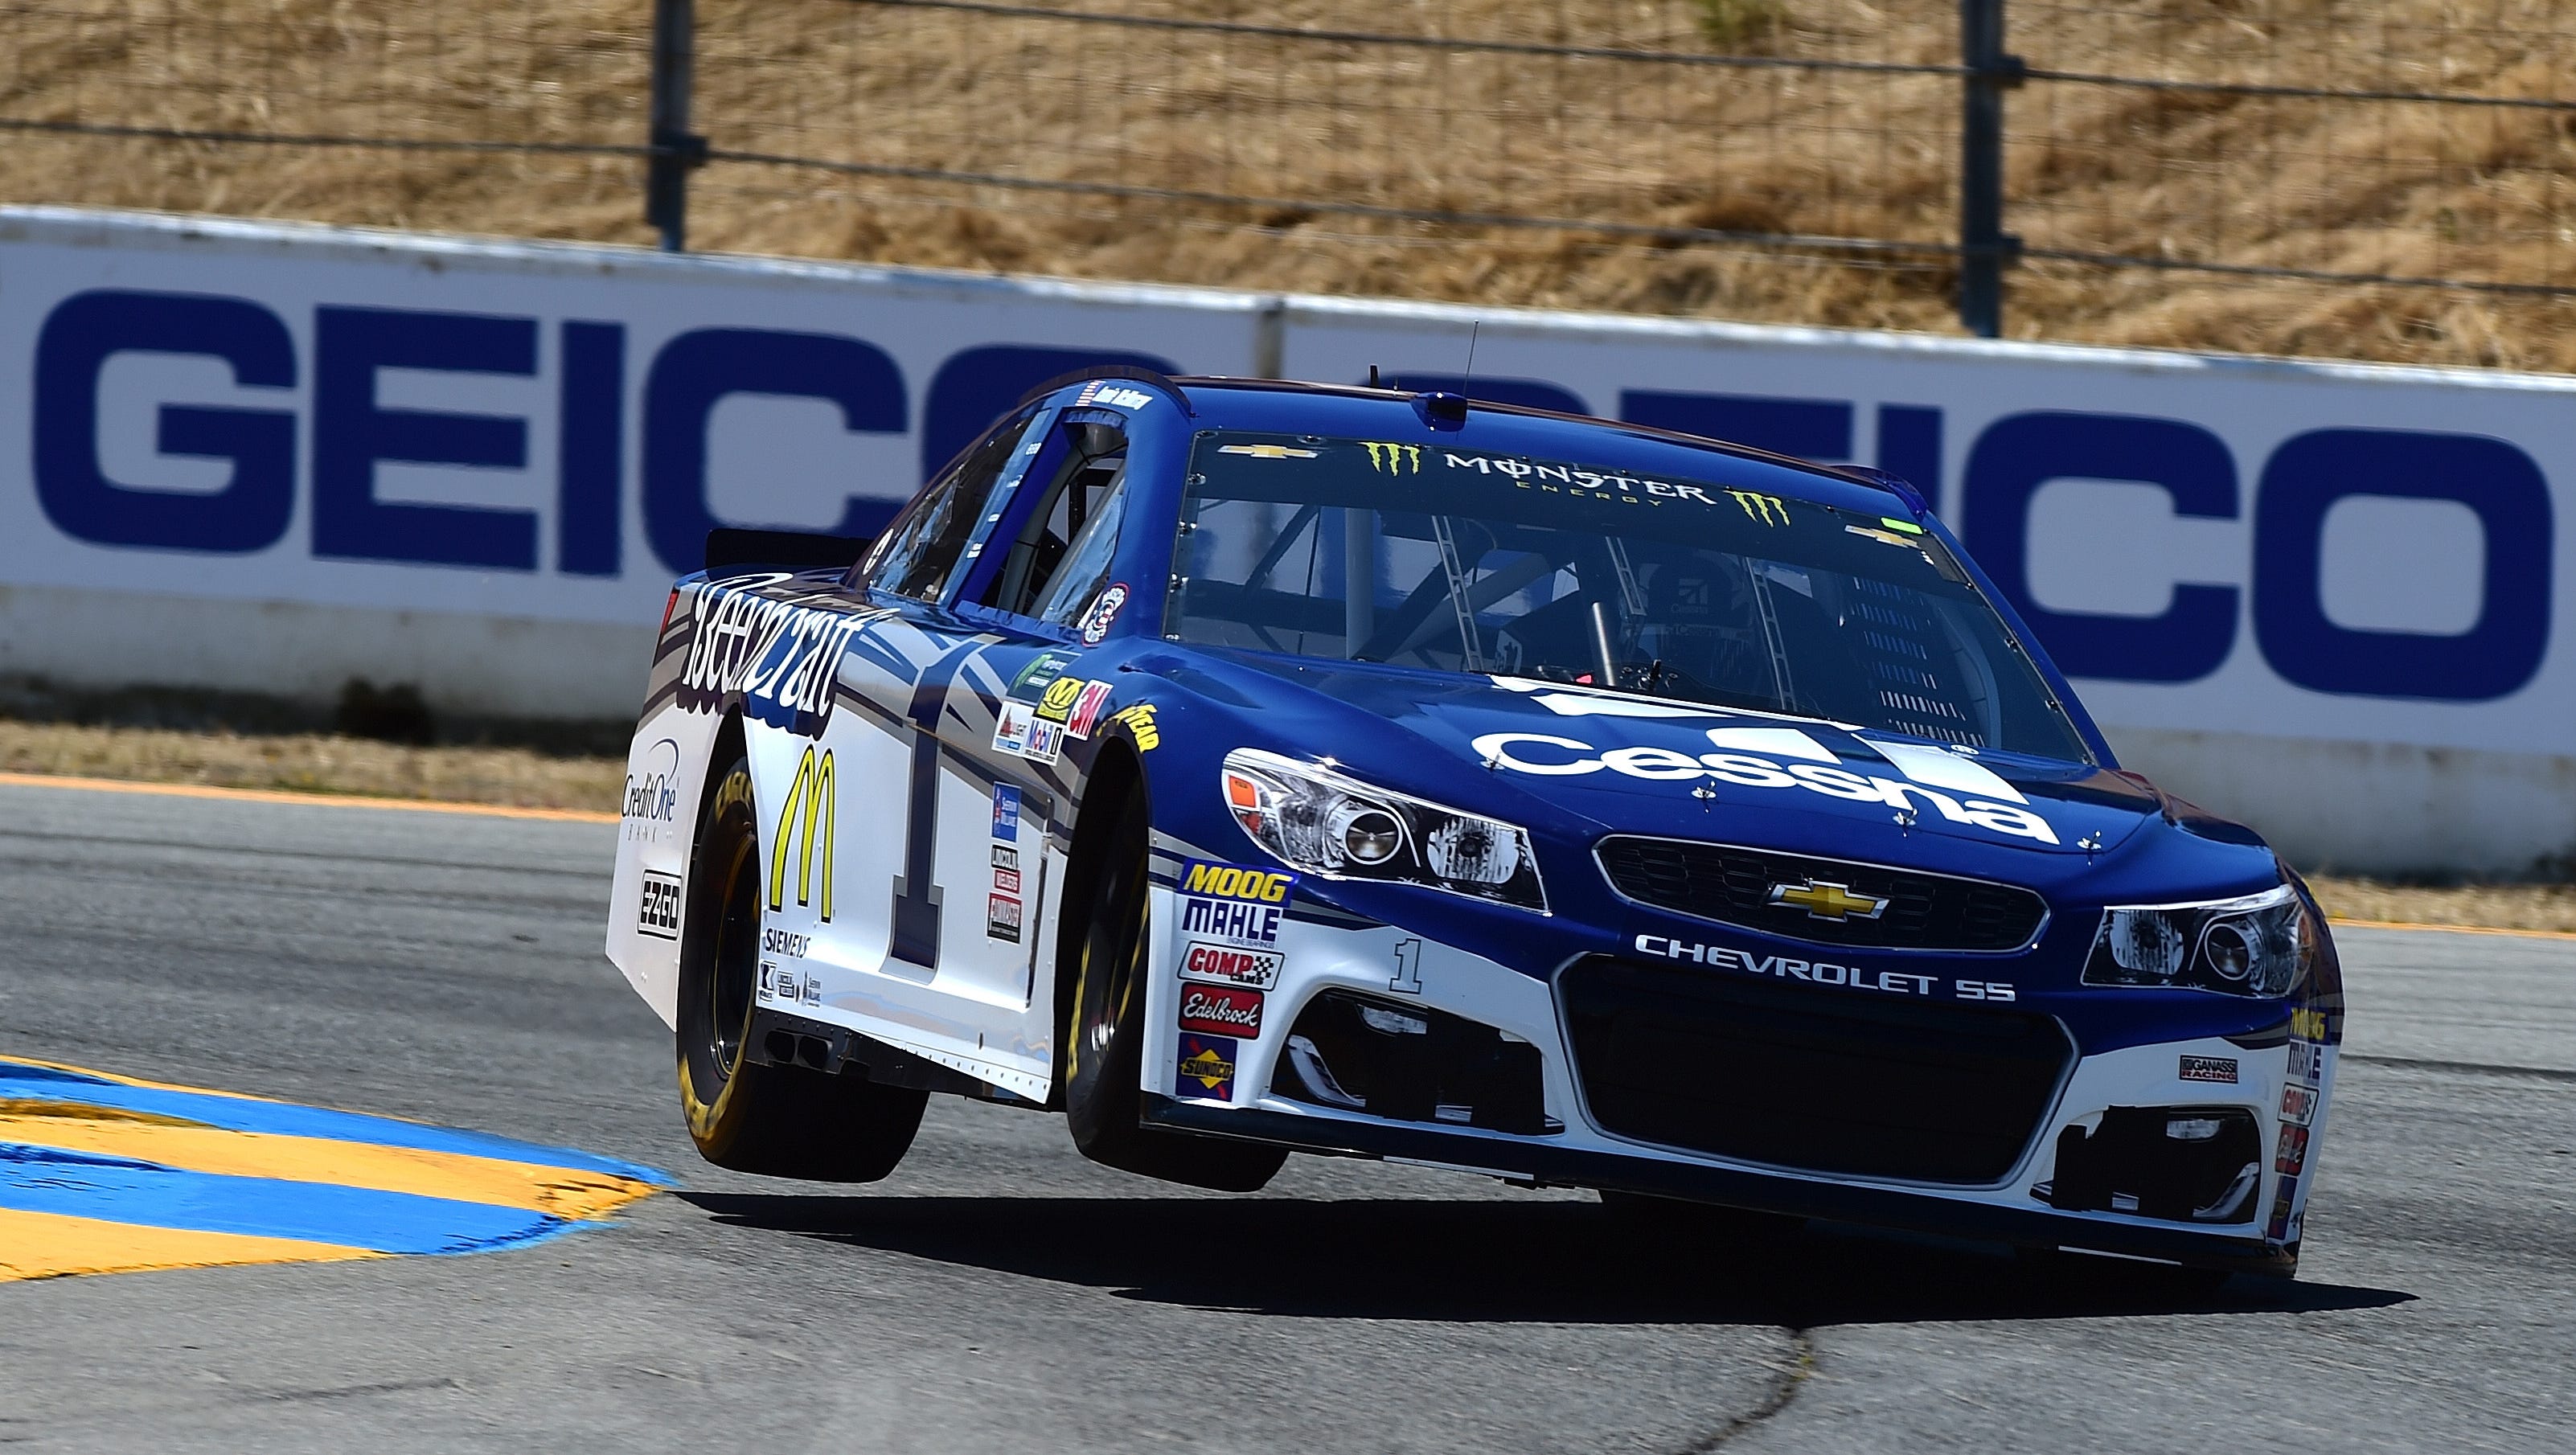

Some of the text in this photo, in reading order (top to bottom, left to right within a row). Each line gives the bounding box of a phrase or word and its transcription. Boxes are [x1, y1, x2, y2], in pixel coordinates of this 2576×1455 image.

[1444, 453, 1717, 505] MONSTER
[1516, 481, 1662, 506] ENERGY
[1069, 685, 1110, 736] 3M
[1471, 732, 2061, 846] Cessna
[628, 823, 658, 842] BANK
[1183, 863, 1294, 903] MOOG
[1182, 898, 1281, 942] MAHLE
[765, 928, 811, 958] SIEMENS
[1188, 947, 1254, 976] COMP
[1389, 938, 1421, 994] 1
[1635, 934, 2016, 1002] CHEVROLET SS
[1230, 973, 1265, 986] CAMS
[1183, 992, 1259, 1027] Edelbrock
[1183, 1059, 1233, 1080] SUNOCO
[2181, 1071, 2237, 1080] RACING
